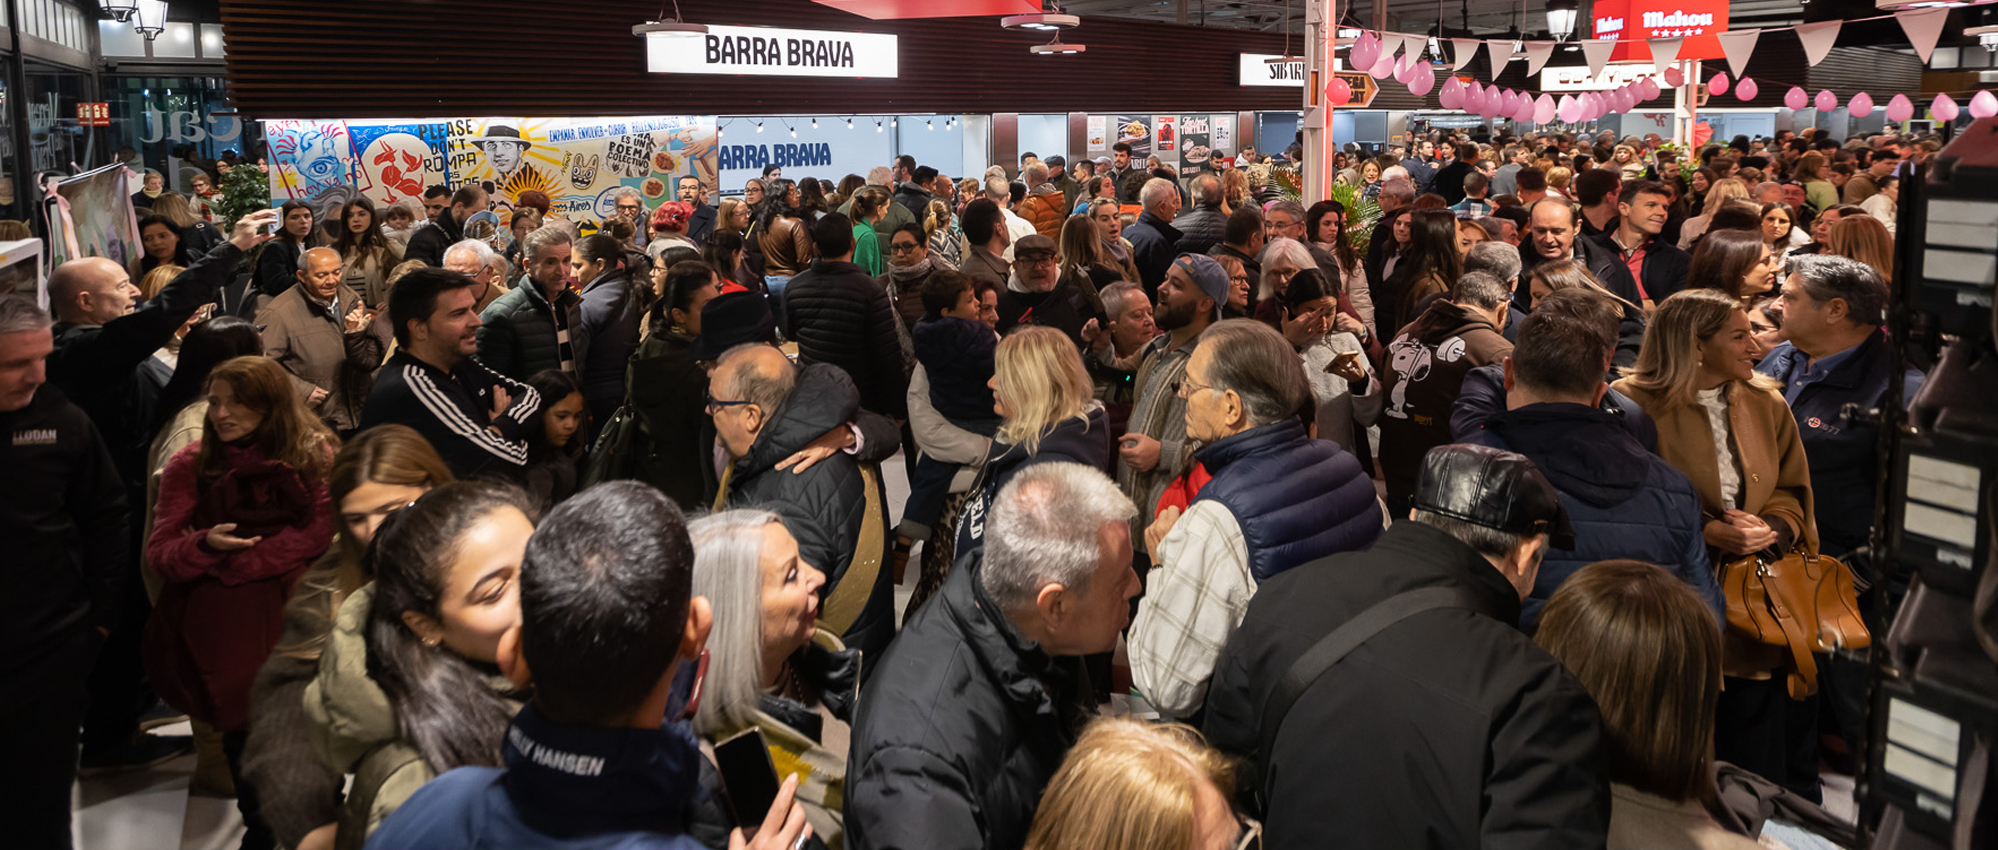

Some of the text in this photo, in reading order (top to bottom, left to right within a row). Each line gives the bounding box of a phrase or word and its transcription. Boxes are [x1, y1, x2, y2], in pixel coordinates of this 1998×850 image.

[1596, 16, 1624, 34] Mahou
[1642, 9, 1713, 28] Mahou
[705, 34, 854, 68] BARRA BRAVA
[1269, 63, 1304, 80] SIBARI
[418, 119, 473, 140] PLEASE
[430, 138, 465, 155] DON'T
[608, 141, 651, 161] POEMA
[621, 135, 631, 144] ES
[633, 138, 646, 148] UN
[423, 152, 477, 174] ROMPA
[607, 151, 649, 168] COLECTIVO
[719, 143, 832, 170] ARRA BRAVA
[294, 182, 320, 199] hoy
[344, 169, 362, 184] no
[569, 200, 592, 213] Aires
[532, 743, 606, 777] HANSEN
